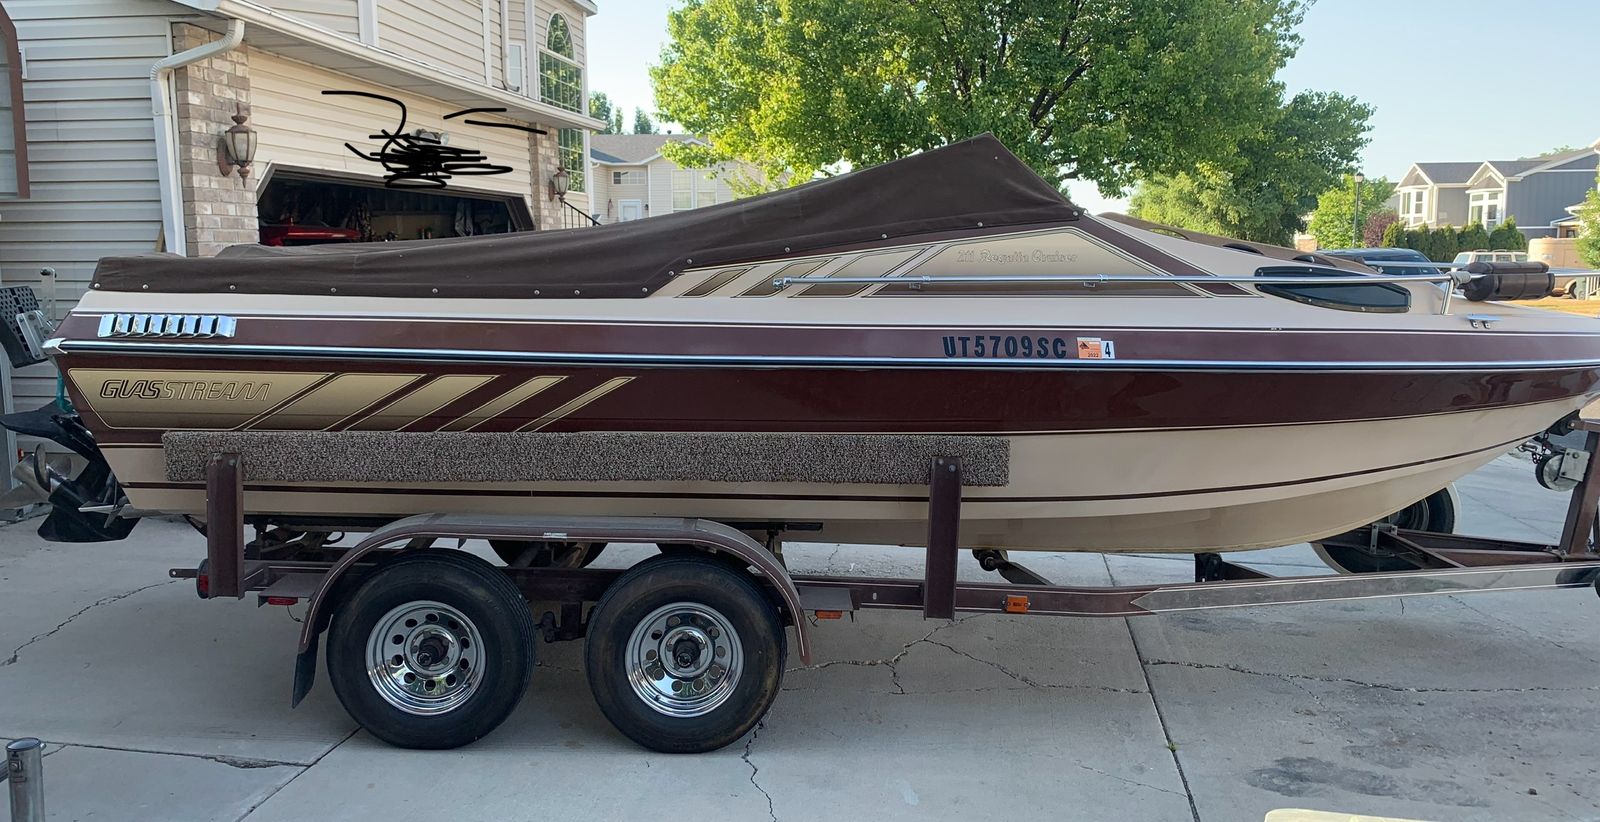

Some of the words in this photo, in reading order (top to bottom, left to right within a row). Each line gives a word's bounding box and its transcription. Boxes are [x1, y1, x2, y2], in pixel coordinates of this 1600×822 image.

[1032, 248, 1078, 263] Cruiser
[942, 336, 1067, 358] UT5709SC
[1105, 342, 1111, 358] 4
